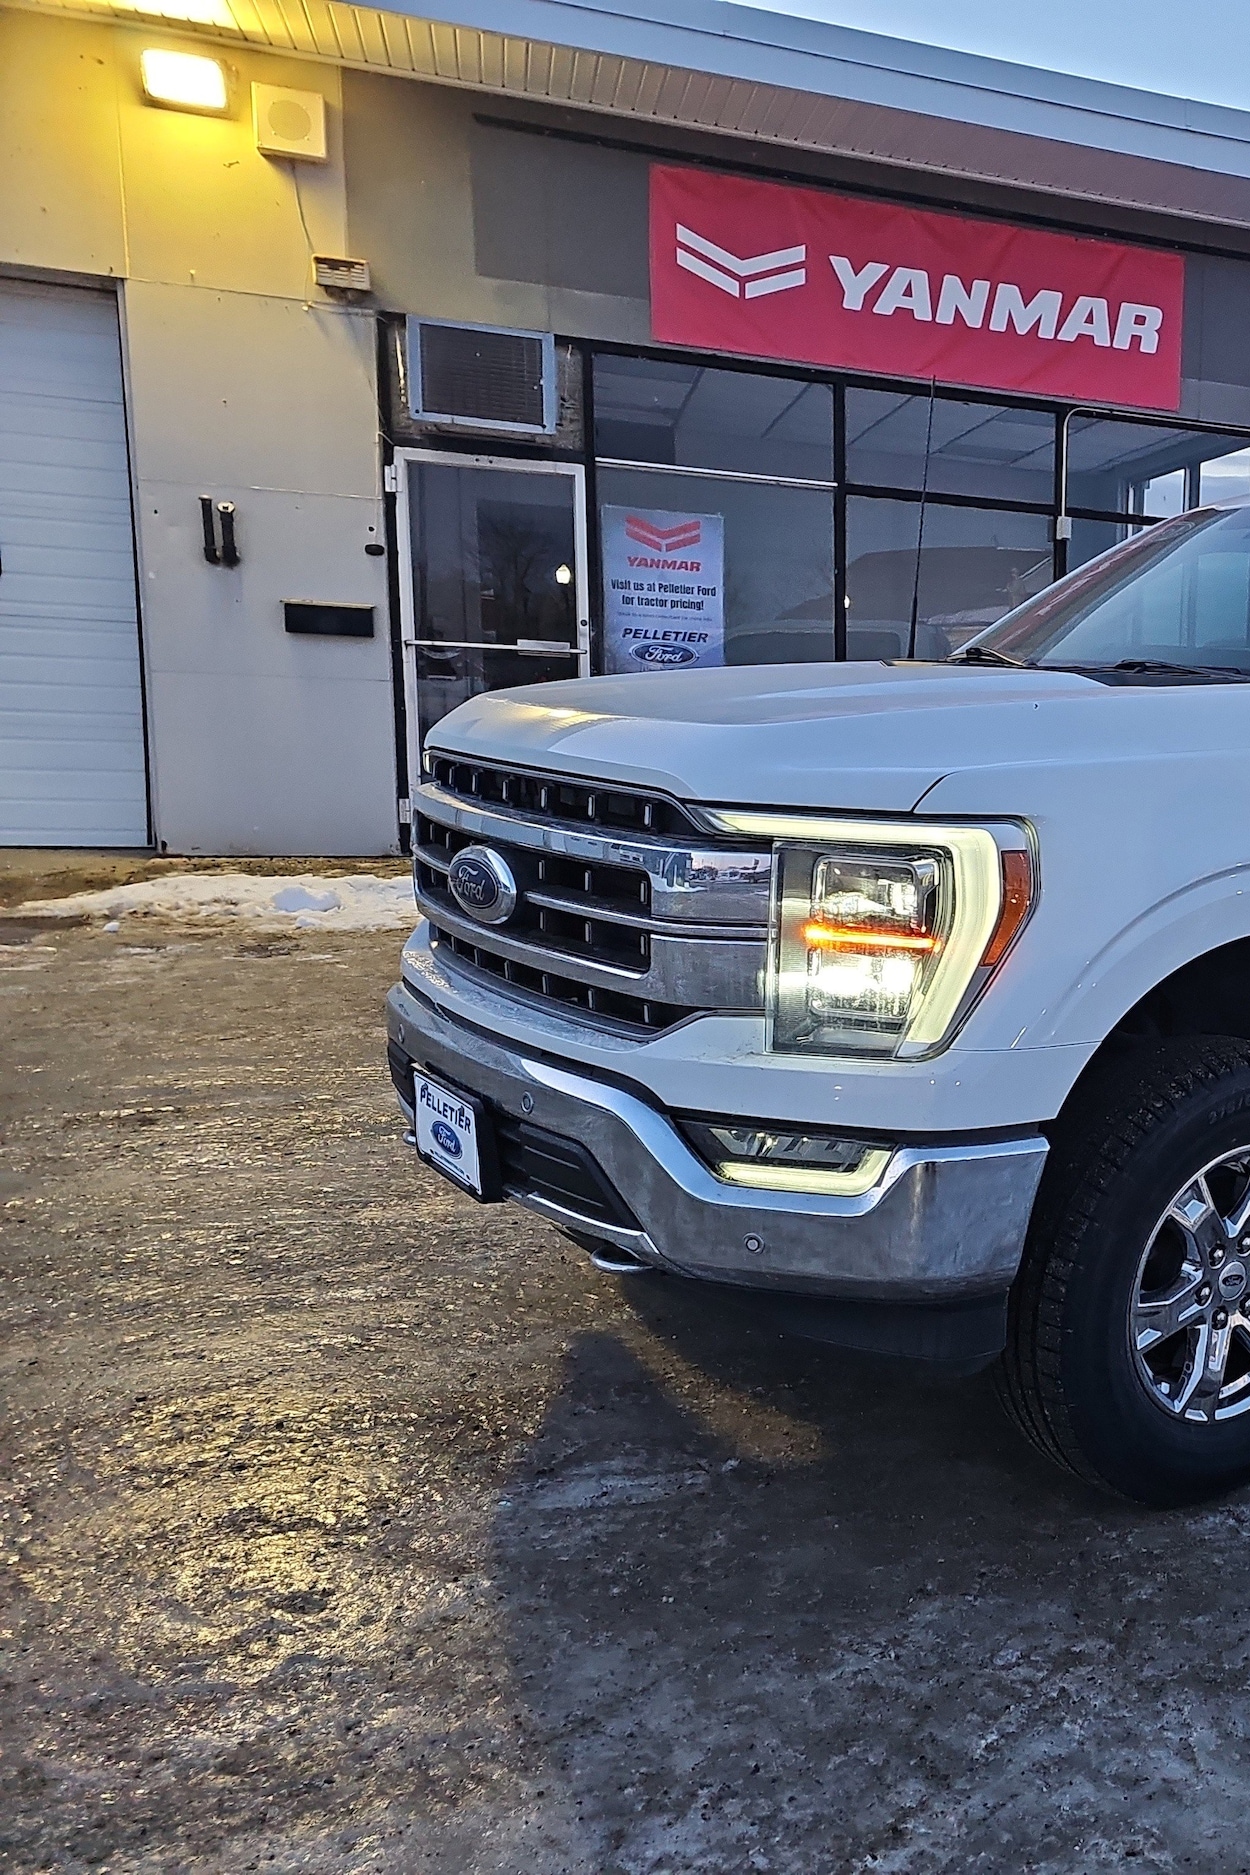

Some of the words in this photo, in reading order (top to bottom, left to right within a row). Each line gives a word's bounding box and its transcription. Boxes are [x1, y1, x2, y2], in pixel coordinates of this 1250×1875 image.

[829, 255, 1163, 354] YANMAR
[626, 556, 702, 572] YANMAR
[611, 579, 631, 590] Visit
[633, 581, 645, 591] us
[647, 582, 656, 592] at
[658, 583, 694, 595] Pelletier
[697, 586, 717, 597] Ford
[622, 595, 634, 605] for
[637, 596, 668, 608] tractor
[670, 599, 704, 611] pricing!
[621, 628, 709, 643] PELLETIER
[644, 645, 683, 663] Ford
[456, 865, 485, 900] Ford
[420, 1083, 471, 1134] PELLETIER
[437, 1126, 457, 1152] Ford
